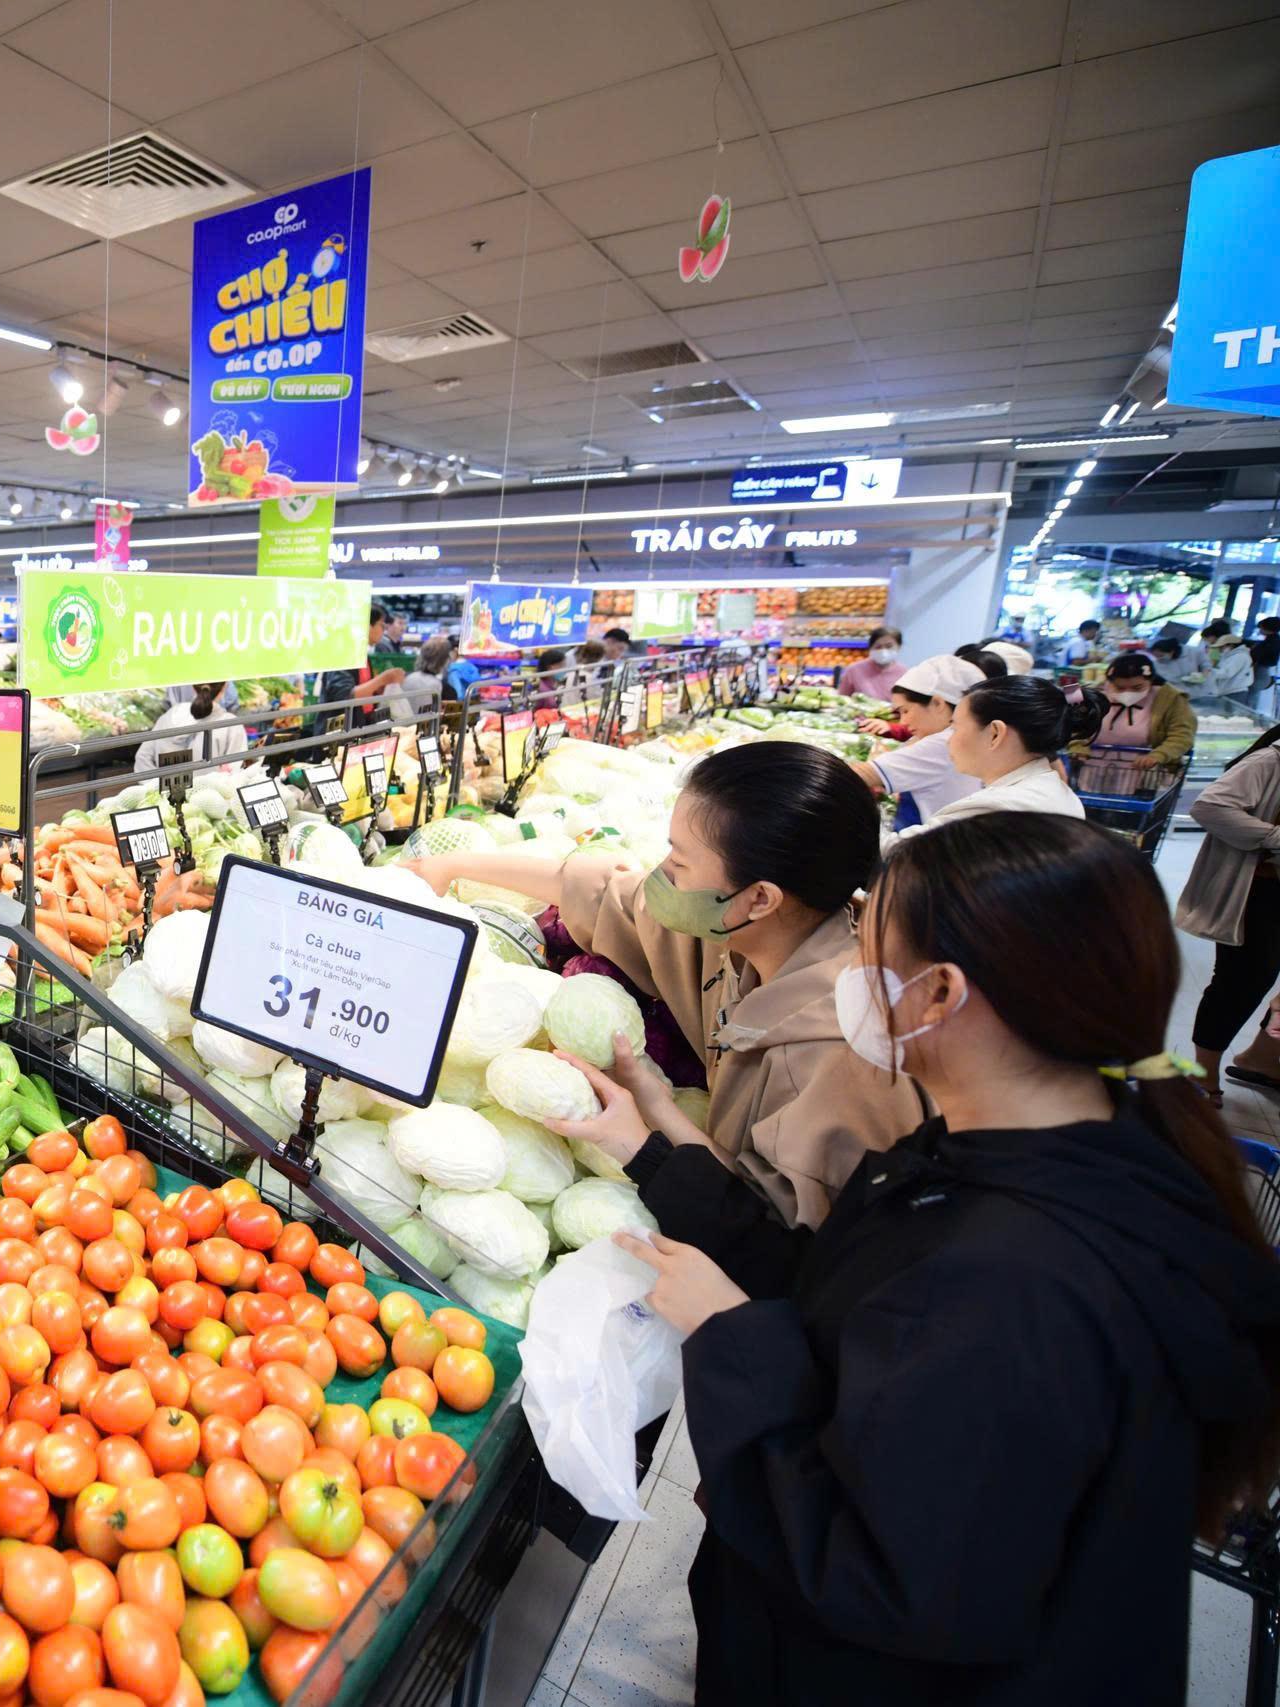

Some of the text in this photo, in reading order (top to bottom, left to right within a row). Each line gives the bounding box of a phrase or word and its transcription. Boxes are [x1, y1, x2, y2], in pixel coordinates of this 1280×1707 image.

[631, 517, 858, 553] TRÁI CÂY FRUITS
[133, 611, 202, 657] RAU
[210, 595, 252, 651] CỦ
[297, 890, 385, 931] BẢNG GIÁ
[327, 938, 362, 962] chua
[329, 1025, 362, 1048] đ/kg
